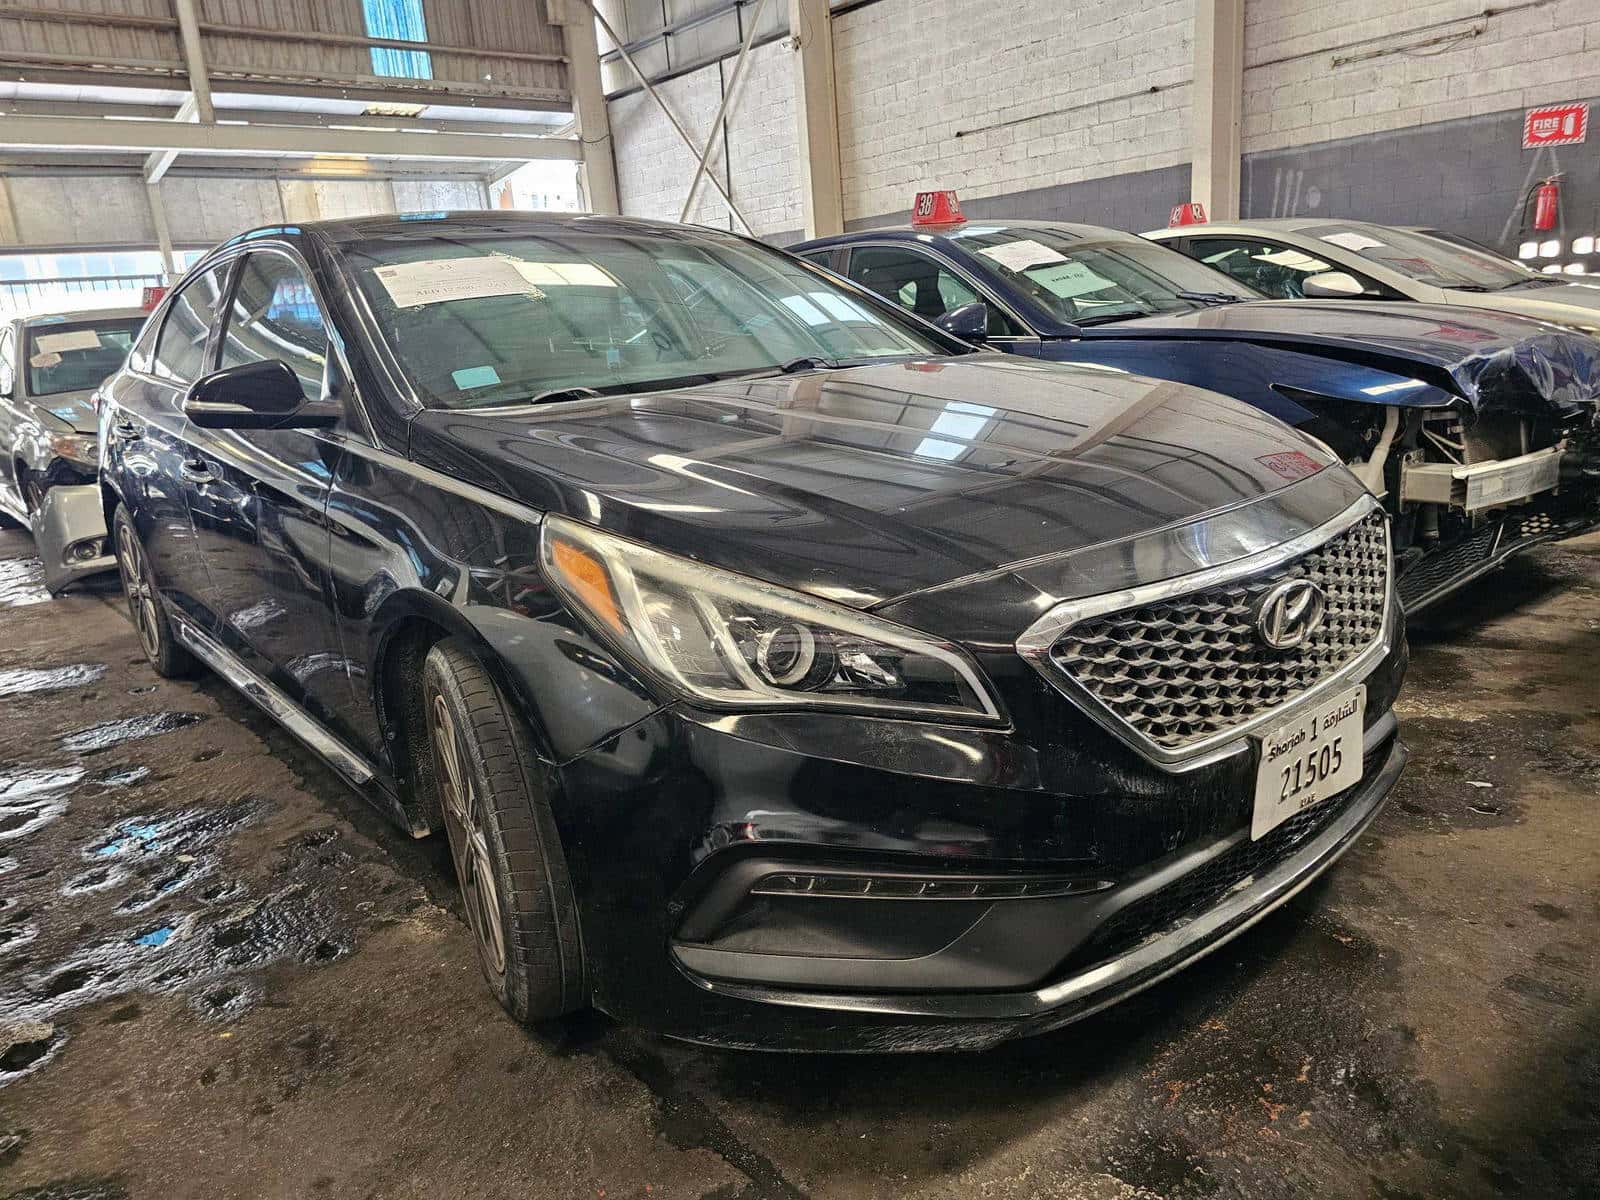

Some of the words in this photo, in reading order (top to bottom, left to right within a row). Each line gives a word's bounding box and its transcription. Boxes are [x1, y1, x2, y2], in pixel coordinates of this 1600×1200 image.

[1533, 117, 1560, 131] FIRE
[918, 193, 933, 215] 38
[1323, 698, 1358, 730] الشارقة
[1268, 728, 1306, 762] Sharjah
[1310, 716, 1319, 742] 1
[1277, 737, 1343, 804] 21505
